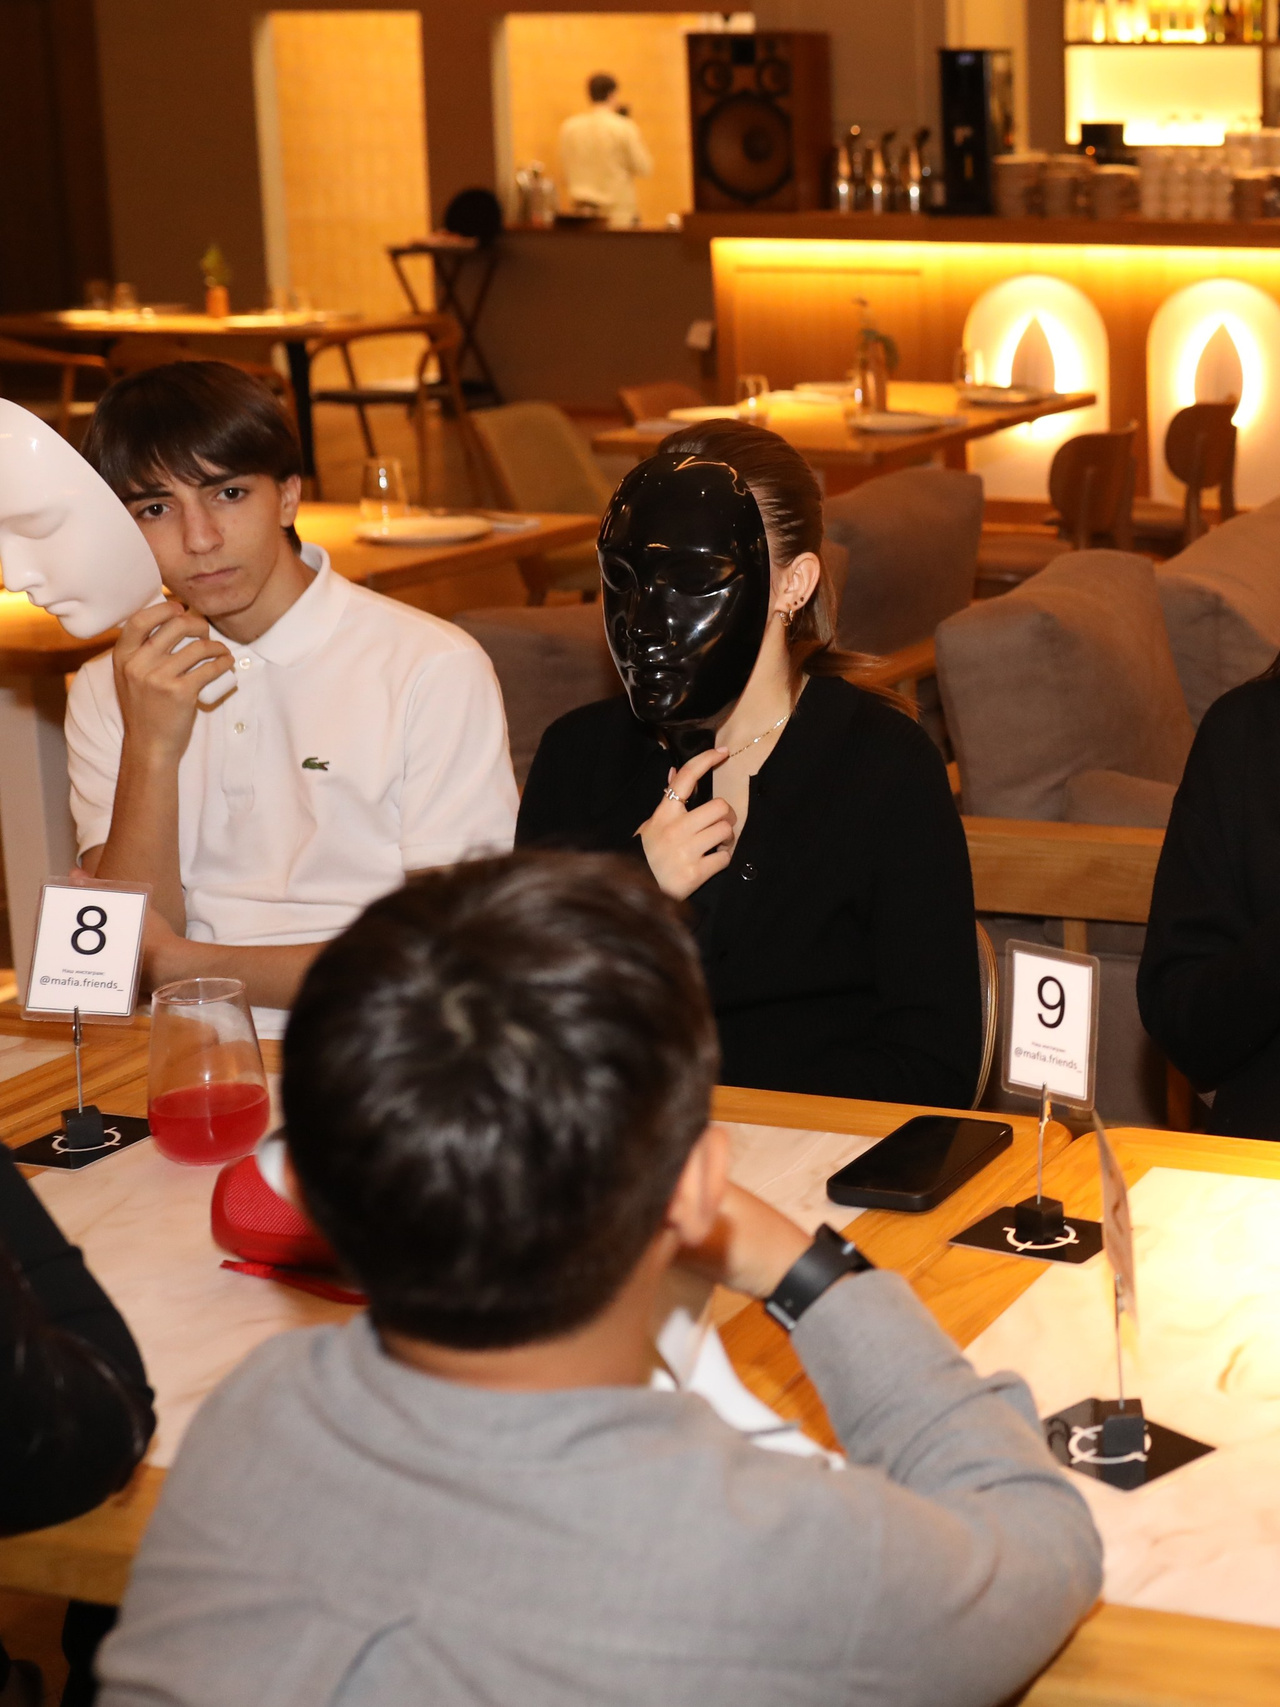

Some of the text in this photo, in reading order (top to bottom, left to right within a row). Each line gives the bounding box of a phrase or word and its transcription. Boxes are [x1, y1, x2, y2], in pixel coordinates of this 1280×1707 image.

[71, 905, 107, 955] 8
[39, 975, 124, 992] @mafia.friends_
[1037, 975, 1065, 1029] 9
